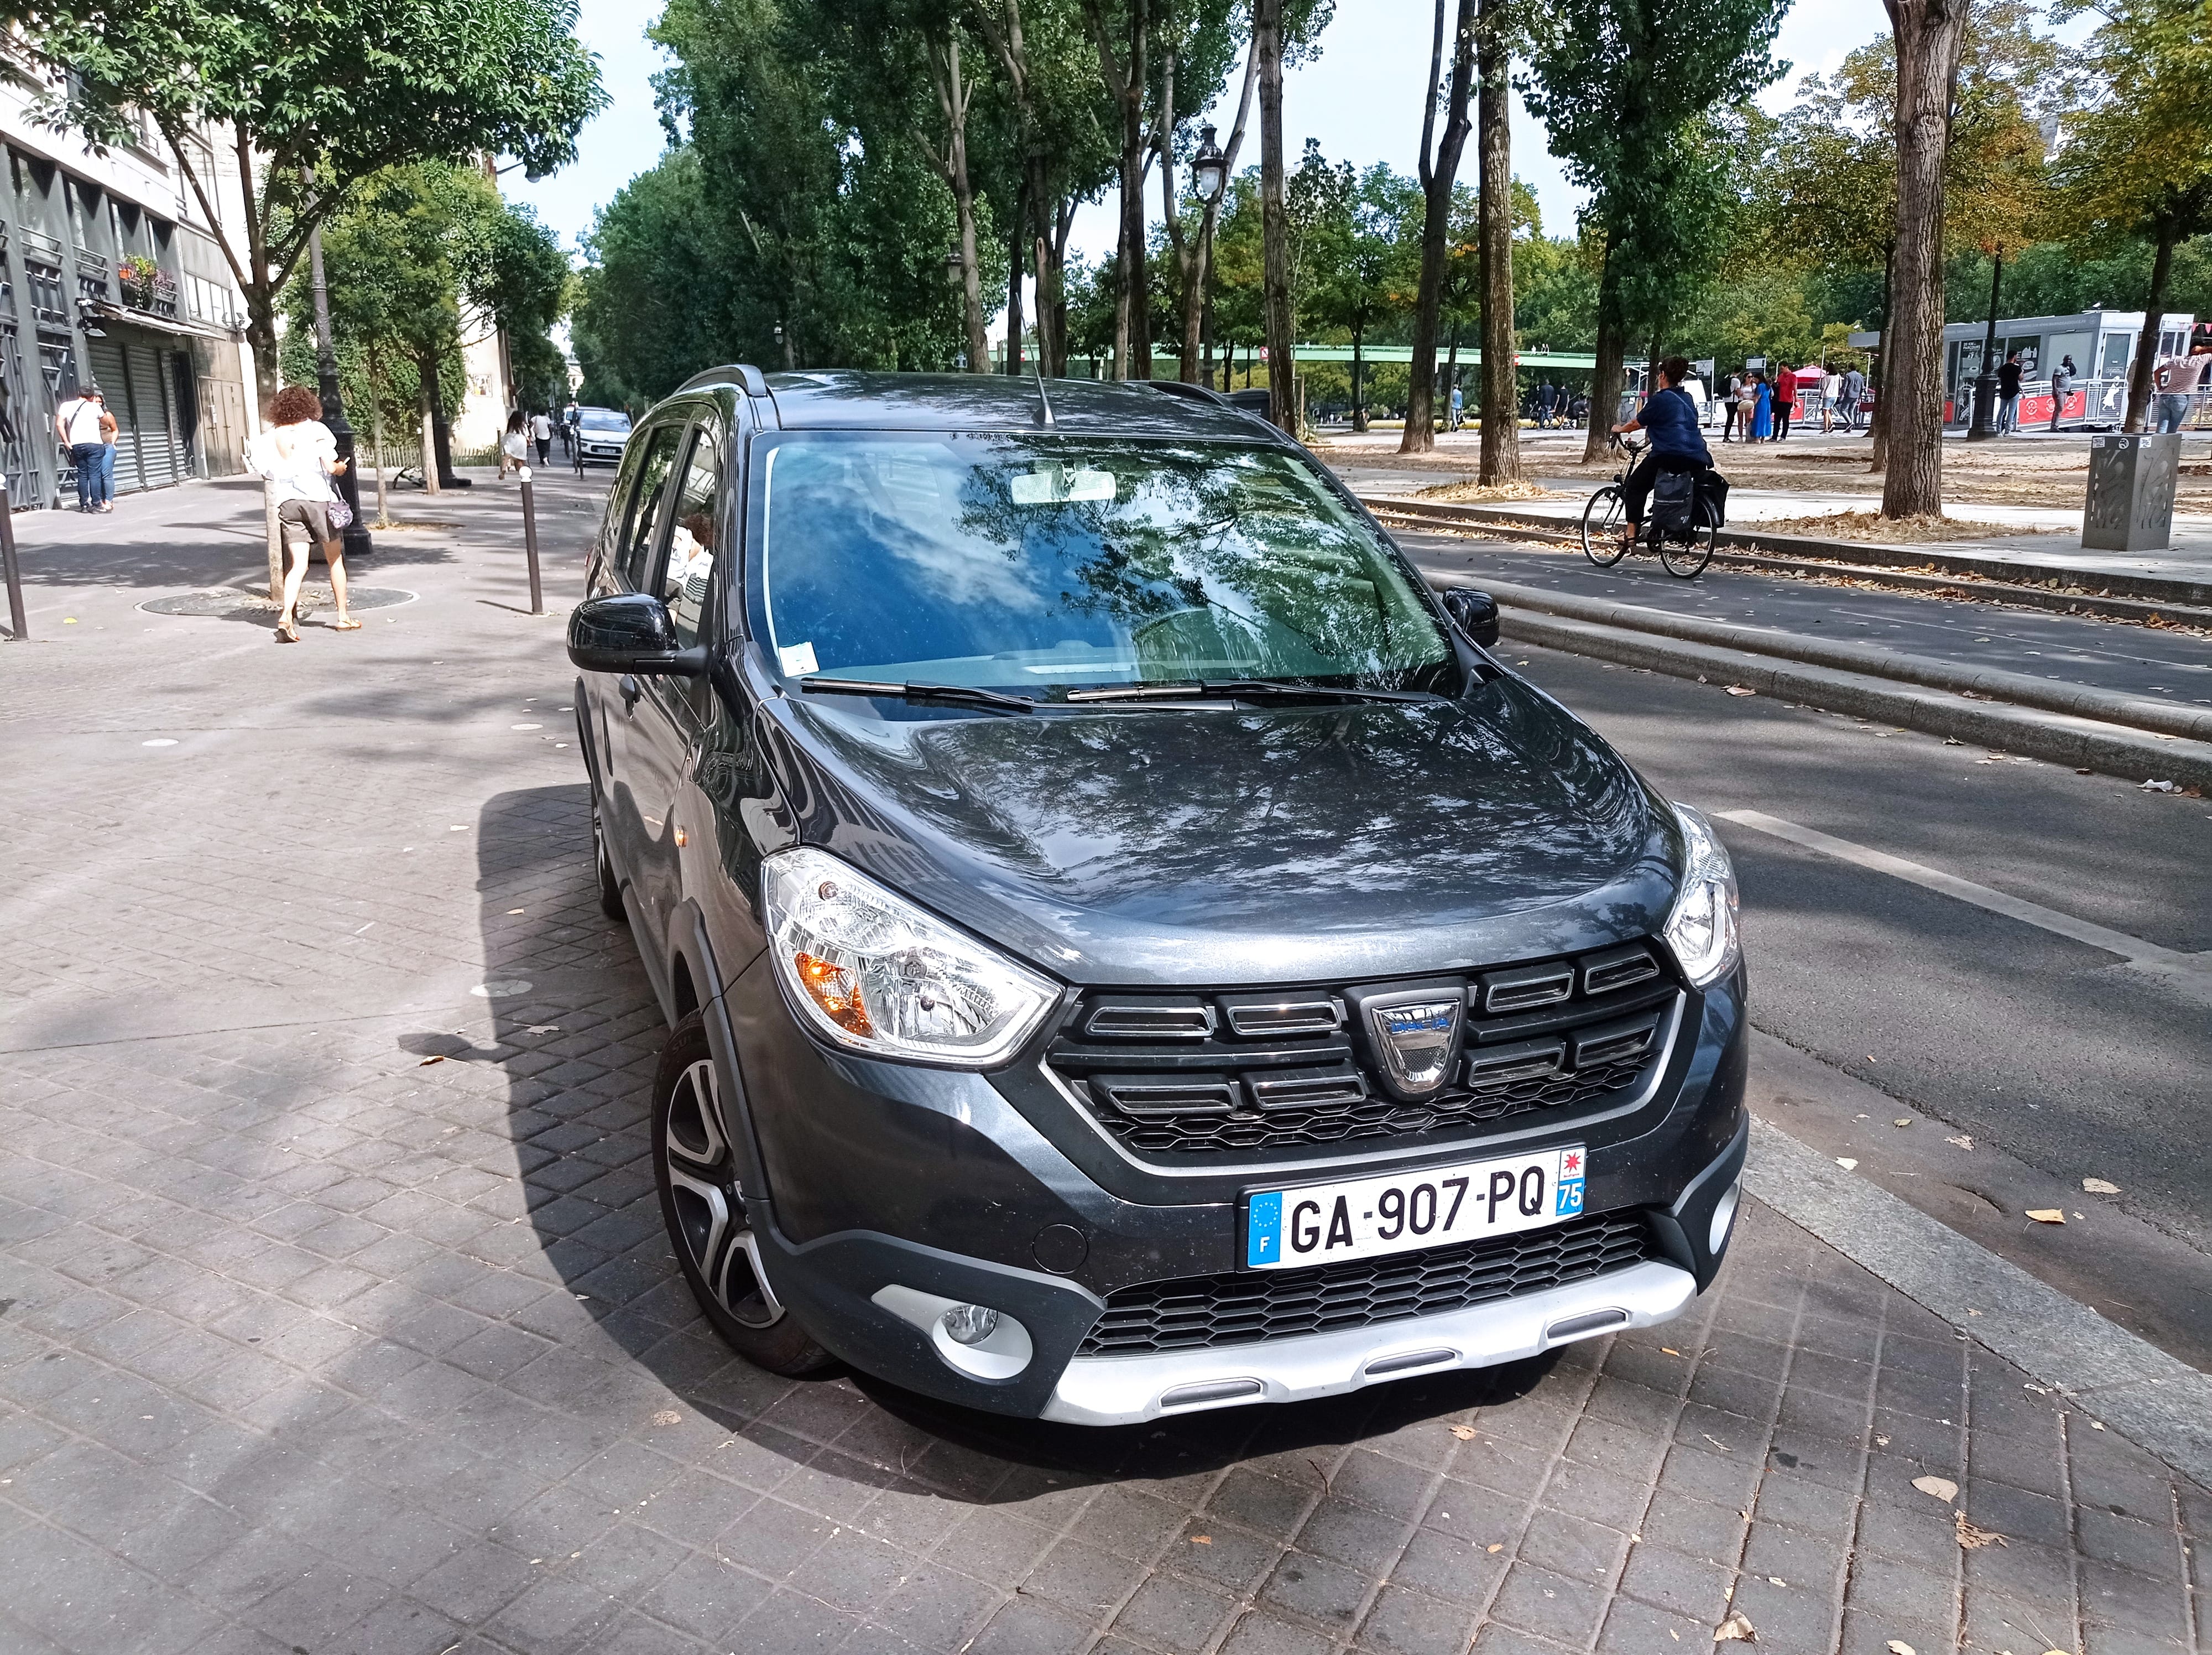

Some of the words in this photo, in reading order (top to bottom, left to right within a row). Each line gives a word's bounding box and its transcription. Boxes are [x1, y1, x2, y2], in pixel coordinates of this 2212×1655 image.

[1391, 1017, 1450, 1034] DACIA
[1558, 1182, 1583, 1210] 75
[1291, 1165, 1545, 1253] GA-907-PQ
[1259, 1236, 1270, 1252] F
